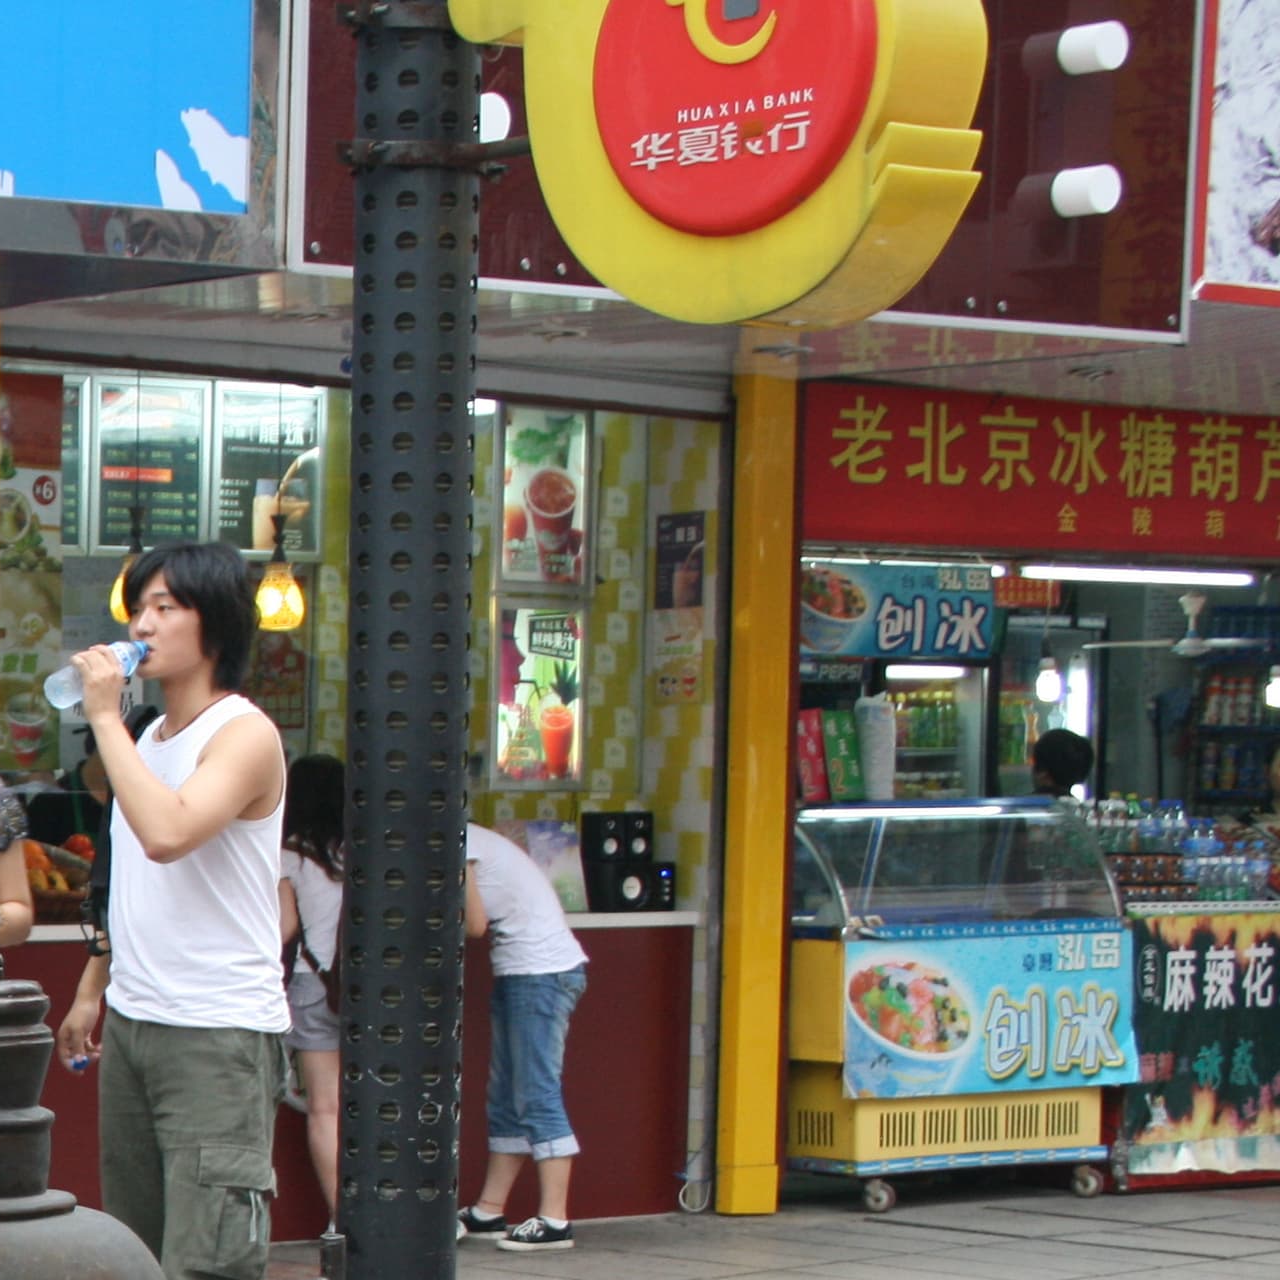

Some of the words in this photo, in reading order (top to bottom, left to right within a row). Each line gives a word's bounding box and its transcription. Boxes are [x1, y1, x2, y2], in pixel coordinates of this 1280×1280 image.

[763, 88, 814, 110] BANK
[630, 111, 811, 171] 华夏银行
[1056, 502, 1280, 541] 金陵葫
[1163, 943, 1275, 1013] 麻辣花
[985, 985, 1123, 1078] 刨冰
